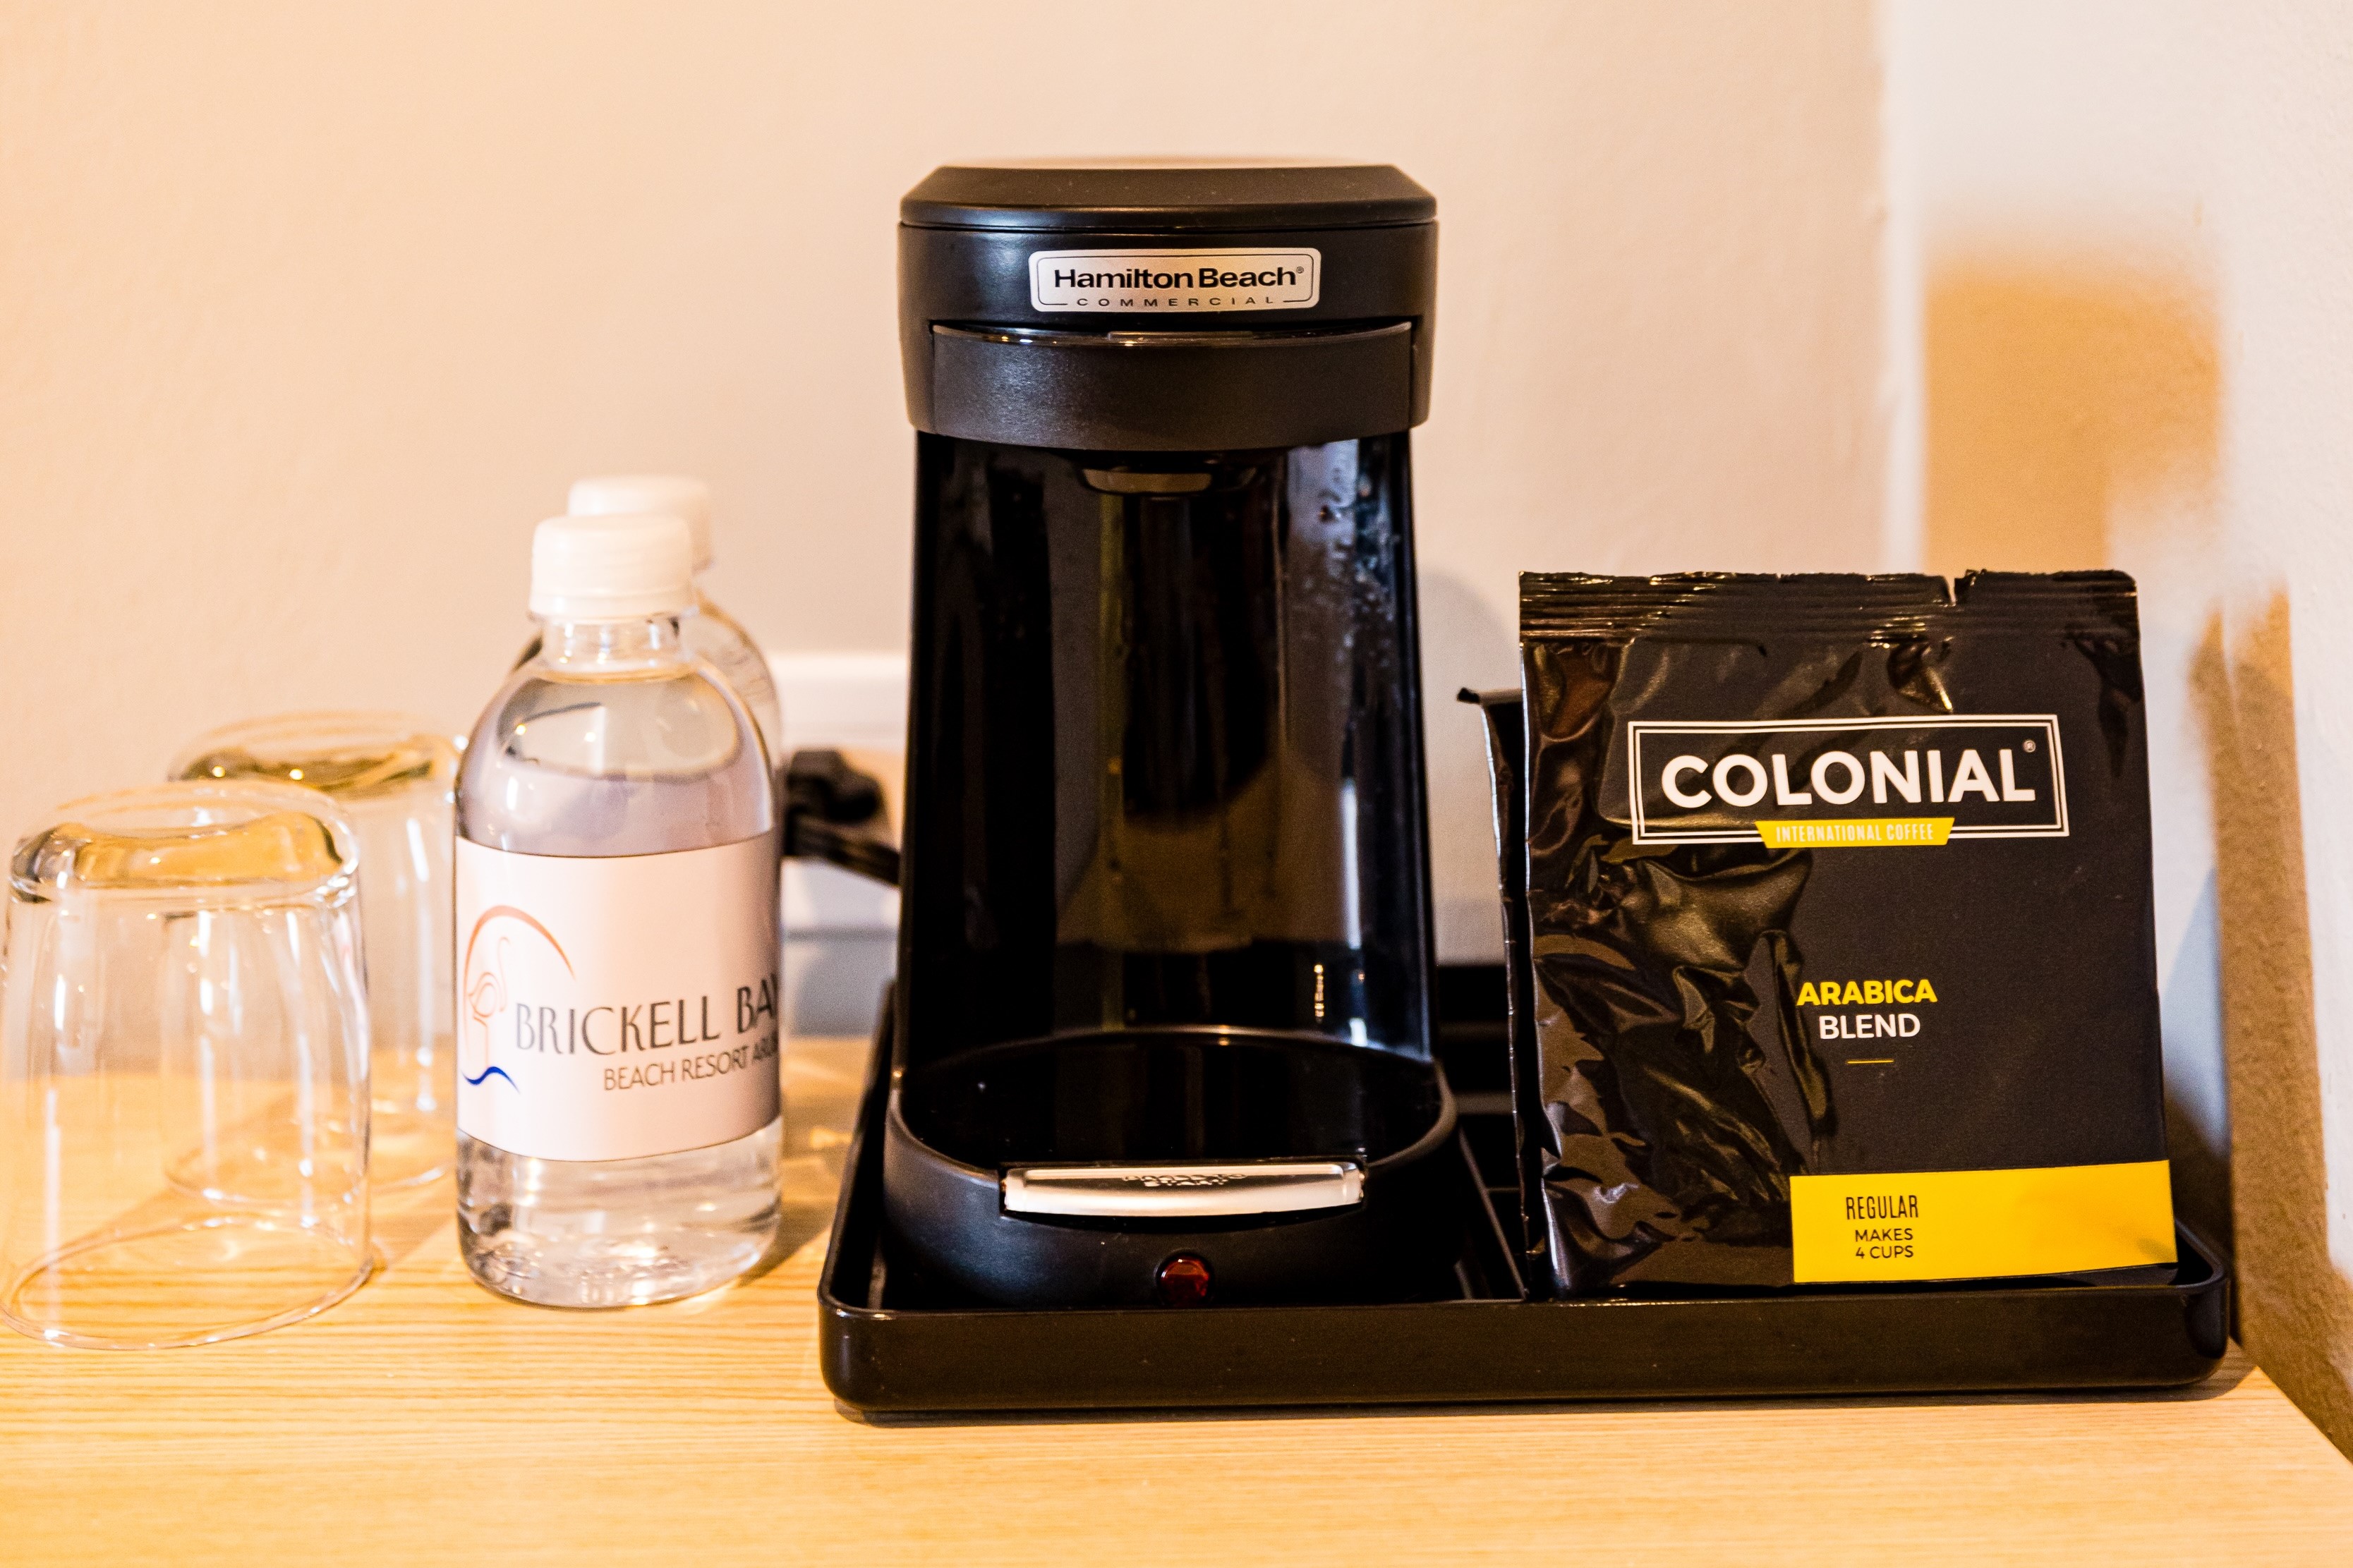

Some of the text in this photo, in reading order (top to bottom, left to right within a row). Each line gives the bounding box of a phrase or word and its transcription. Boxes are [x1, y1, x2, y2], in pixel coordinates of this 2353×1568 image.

[1054, 267, 1194, 289] Hamilton
[1077, 296, 1274, 307] COMMERCIAL
[1775, 822, 1935, 844] INTERNATIONAL COFFEE
[1796, 978, 1938, 1007] ARABICA
[515, 995, 720, 1057] BRICKELL
[1818, 1013, 1921, 1040] BLEND
[603, 1061, 676, 1092] BEACH
[681, 1045, 749, 1081] RESORT
[1845, 1194, 1919, 1220] REGULAR
[1854, 1227, 1914, 1242] MAKES
[1855, 1244, 1914, 1259] 4 CUPS
